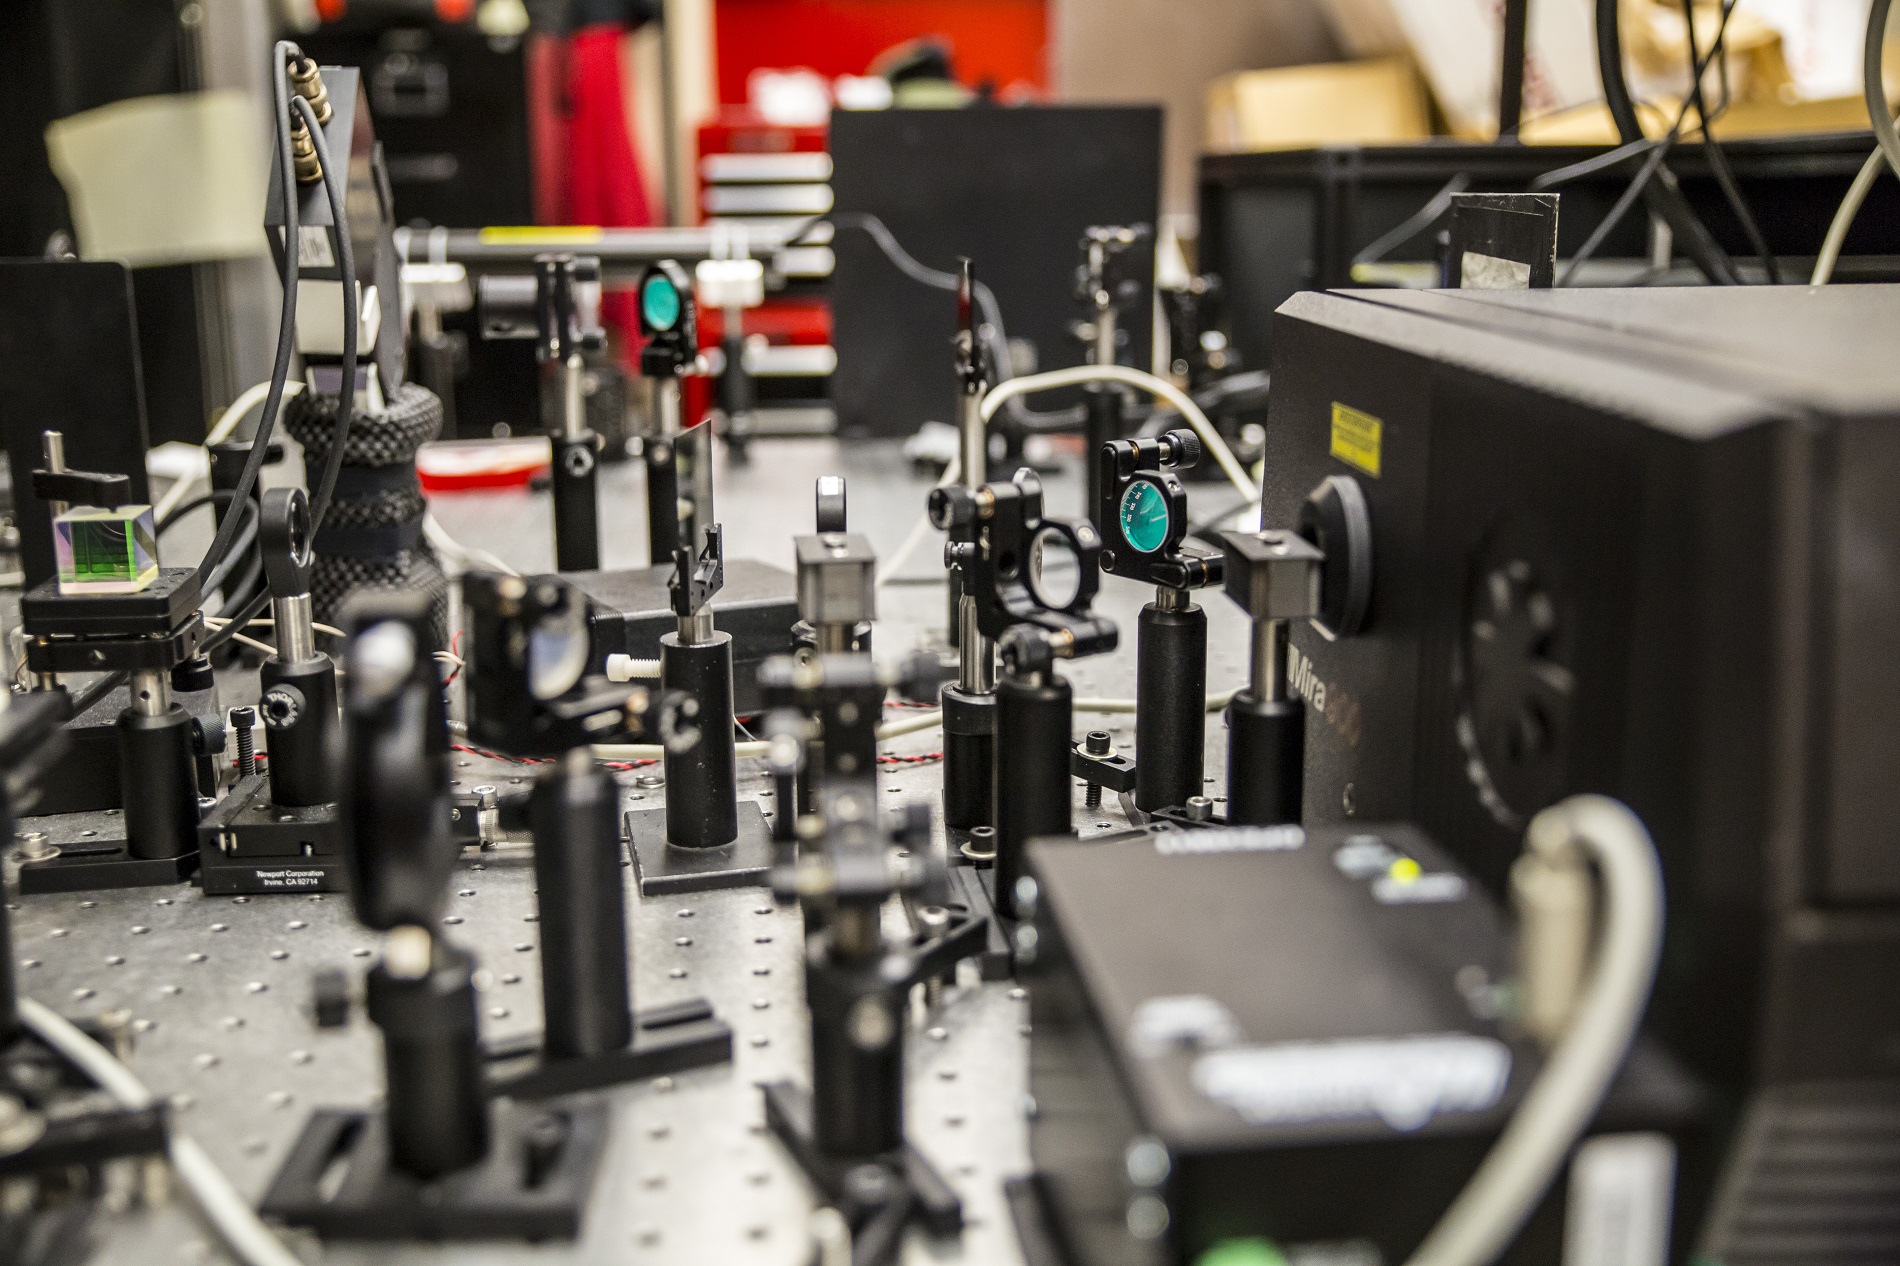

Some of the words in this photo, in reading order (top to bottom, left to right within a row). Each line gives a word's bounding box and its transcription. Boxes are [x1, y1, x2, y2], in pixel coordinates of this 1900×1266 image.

[1287, 642, 1327, 713] Mira
[257, 870, 284, 878] Newport
[286, 870, 324, 878] Corporation
